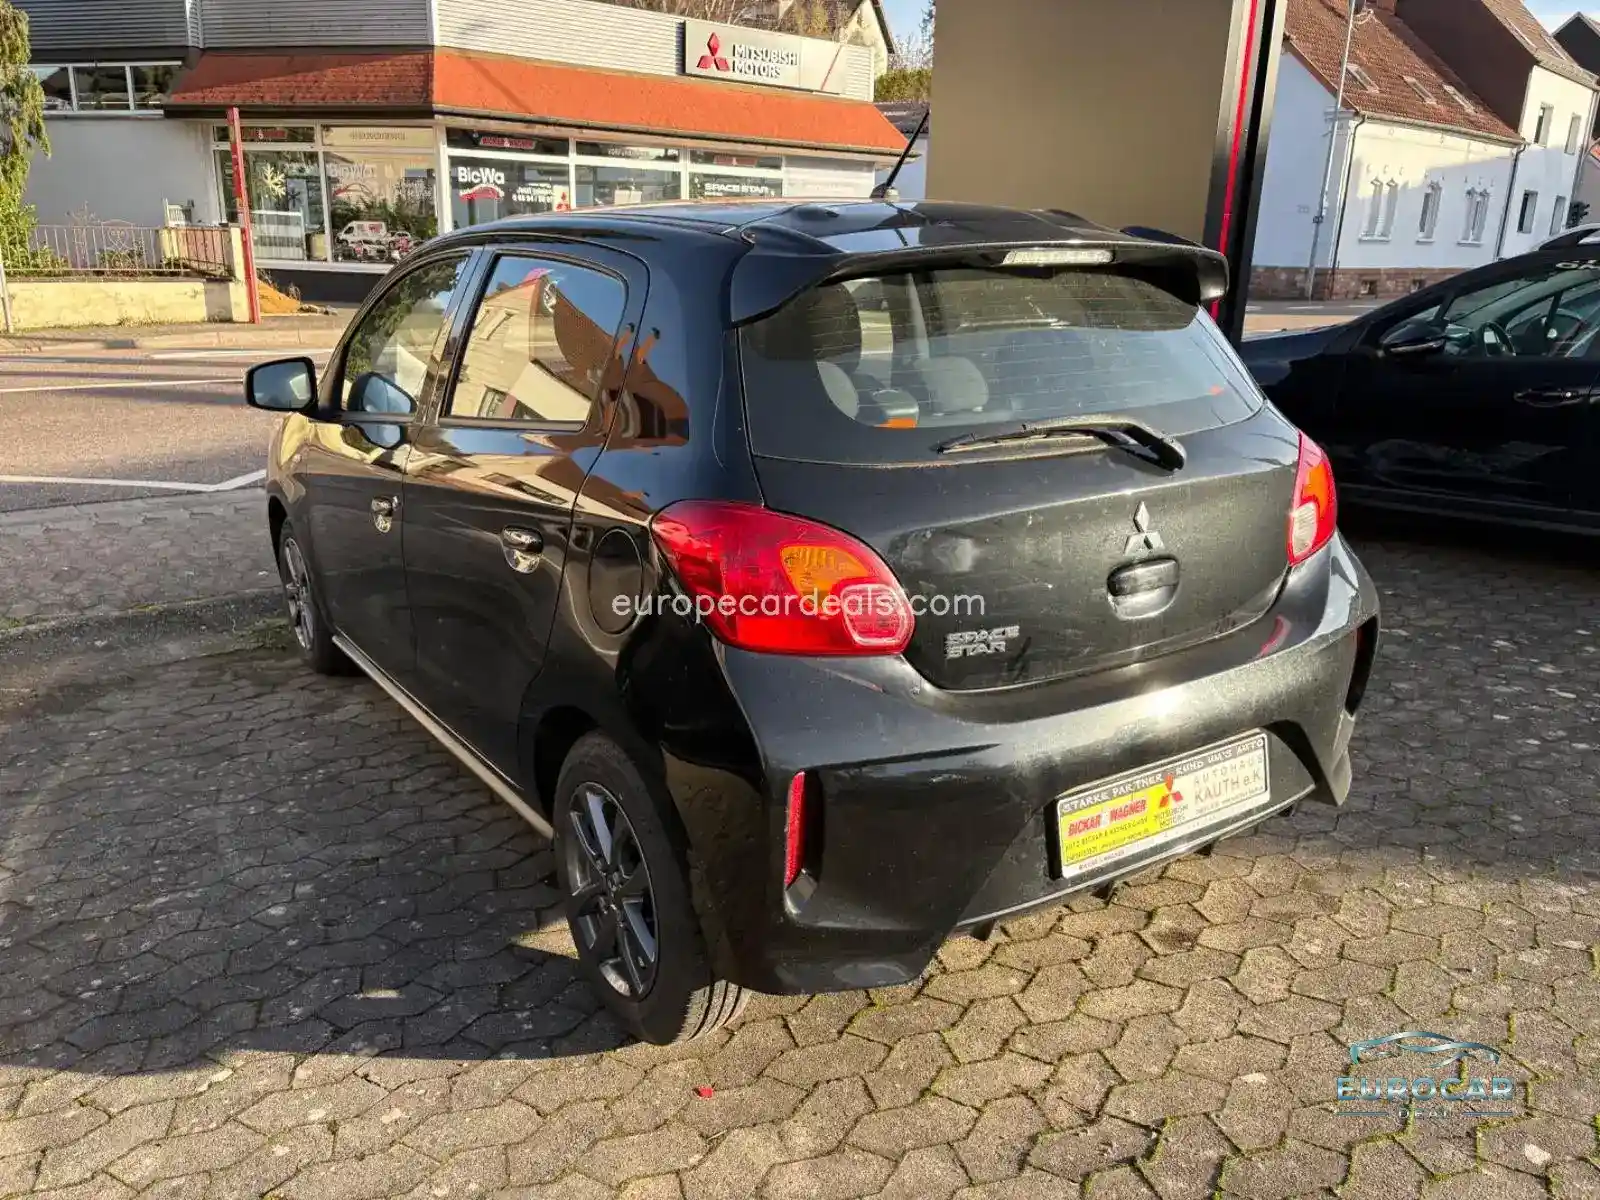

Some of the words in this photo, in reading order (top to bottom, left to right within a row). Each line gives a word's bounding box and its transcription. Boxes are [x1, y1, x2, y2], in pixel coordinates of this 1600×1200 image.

[732, 44, 800, 66] MITSUBISHI
[732, 60, 781, 79] MOTORS
[457, 166, 505, 185] BicWa
[704, 183, 740, 193] SPACE
[944, 625, 1020, 645] SPACE
[944, 640, 1006, 660] STAR
[1062, 792, 1110, 813] STARKE
[1109, 799, 1148, 822] WAGNER
